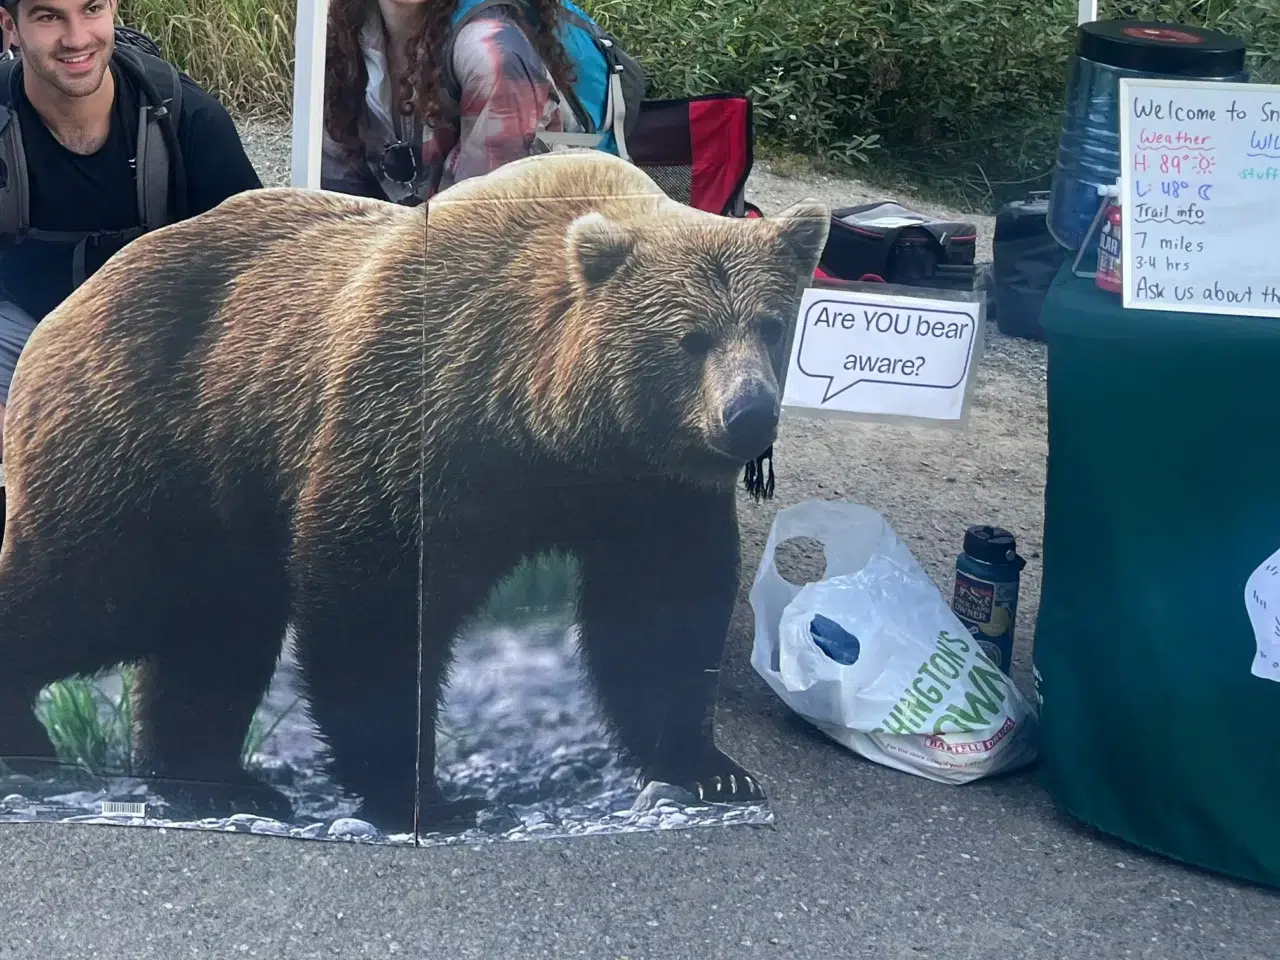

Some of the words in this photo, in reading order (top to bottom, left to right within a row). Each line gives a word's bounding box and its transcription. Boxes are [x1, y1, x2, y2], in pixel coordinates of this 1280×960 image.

[1133, 96, 1217, 122] Welcome
[1226, 100, 1247, 122] to
[1139, 127, 1212, 145] Weather
[1135, 202, 1169, 219] Trail
[1176, 202, 1205, 219] info
[1134, 232, 1147, 249] 7
[1160, 235, 1204, 253] miles
[1166, 256, 1190, 271] hrs
[1136, 276, 1165, 301] Ask
[1174, 286, 1194, 300] us
[1203, 280, 1252, 303] about
[814, 306, 856, 330] Are
[863, 310, 912, 335] YOU
[915, 315, 969, 340] bear
[843, 353, 926, 377] aware?
[954, 602, 987, 621] OWNER
